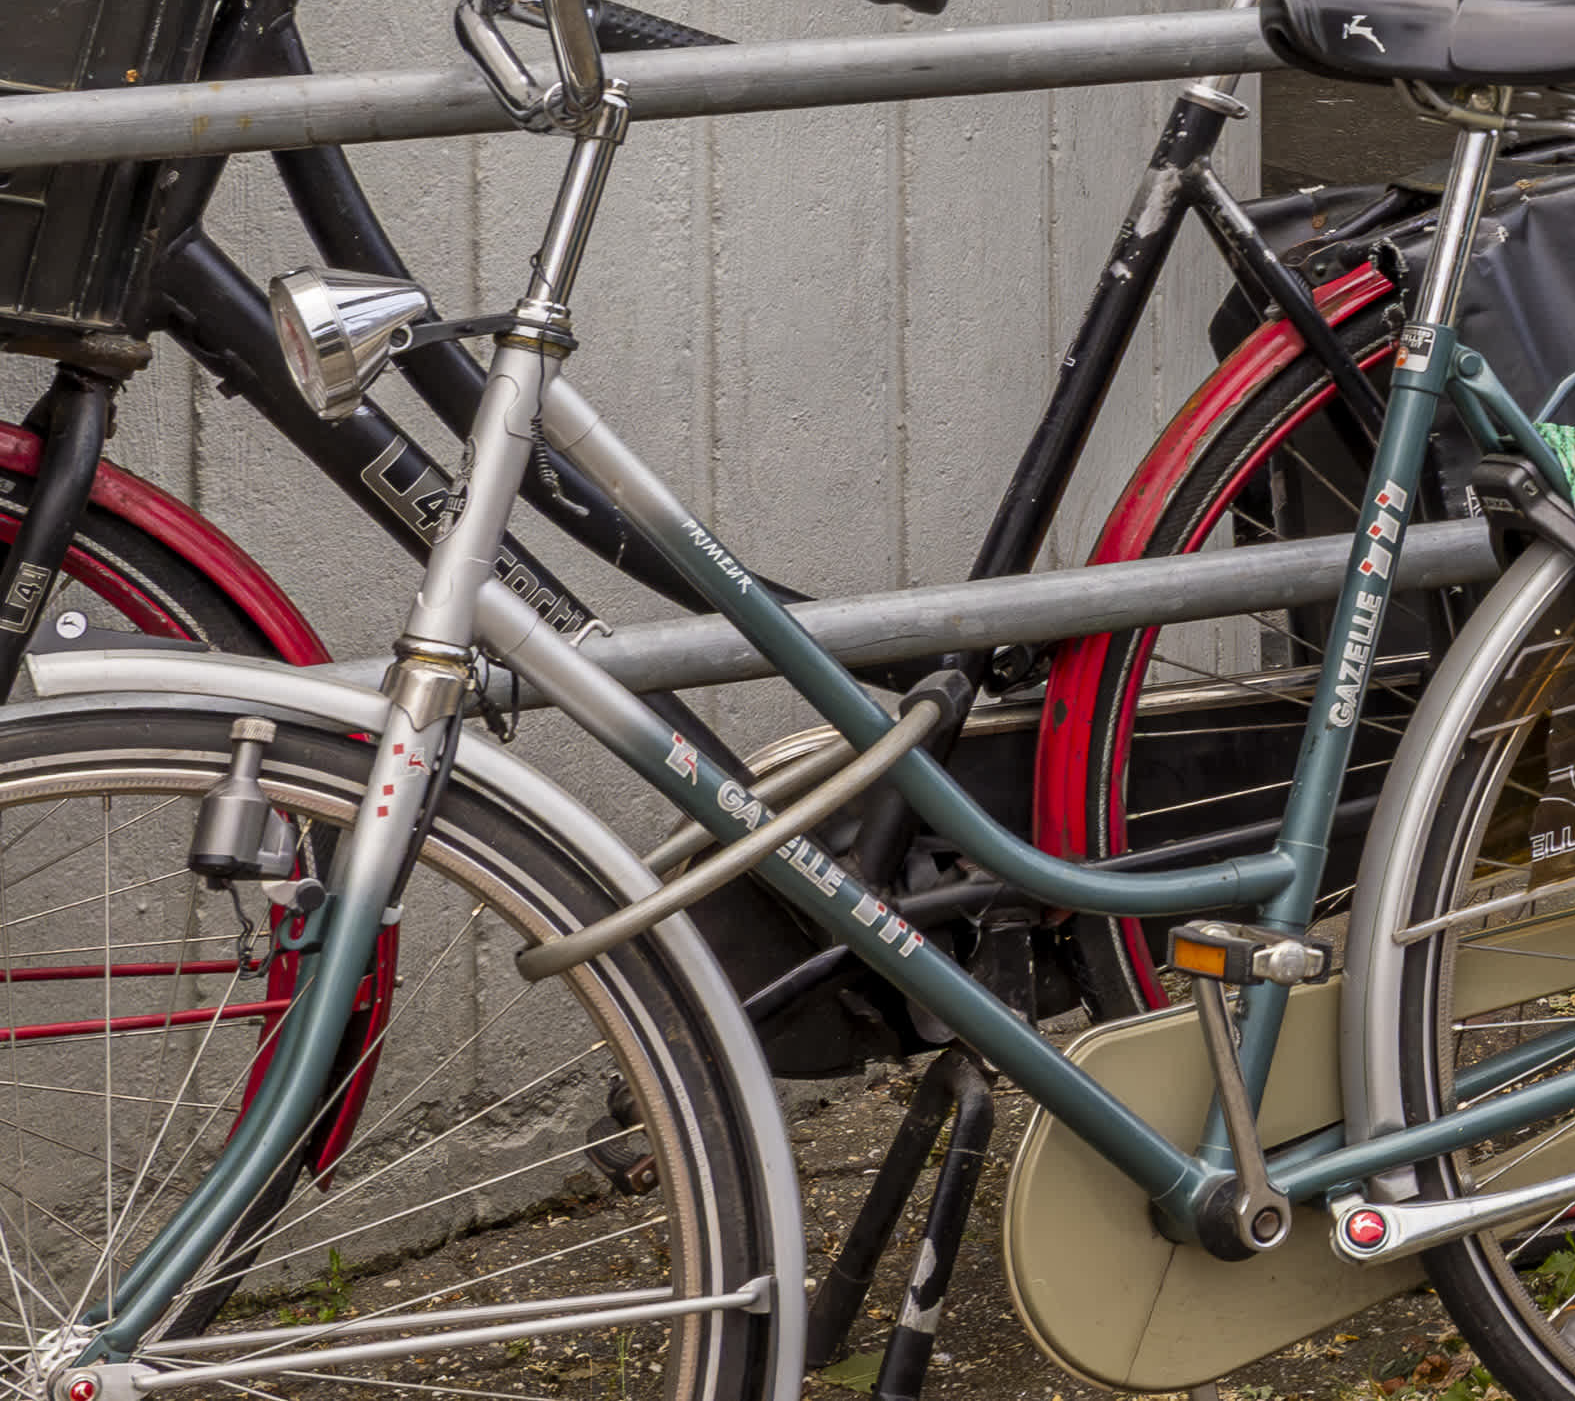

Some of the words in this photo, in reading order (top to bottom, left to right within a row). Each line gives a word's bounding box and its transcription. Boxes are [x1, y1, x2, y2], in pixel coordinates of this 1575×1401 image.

[681, 518, 753, 594] PRIMEUR
[1328, 590, 1383, 728] GAZELLE
[717, 779, 847, 897] GAELLE
